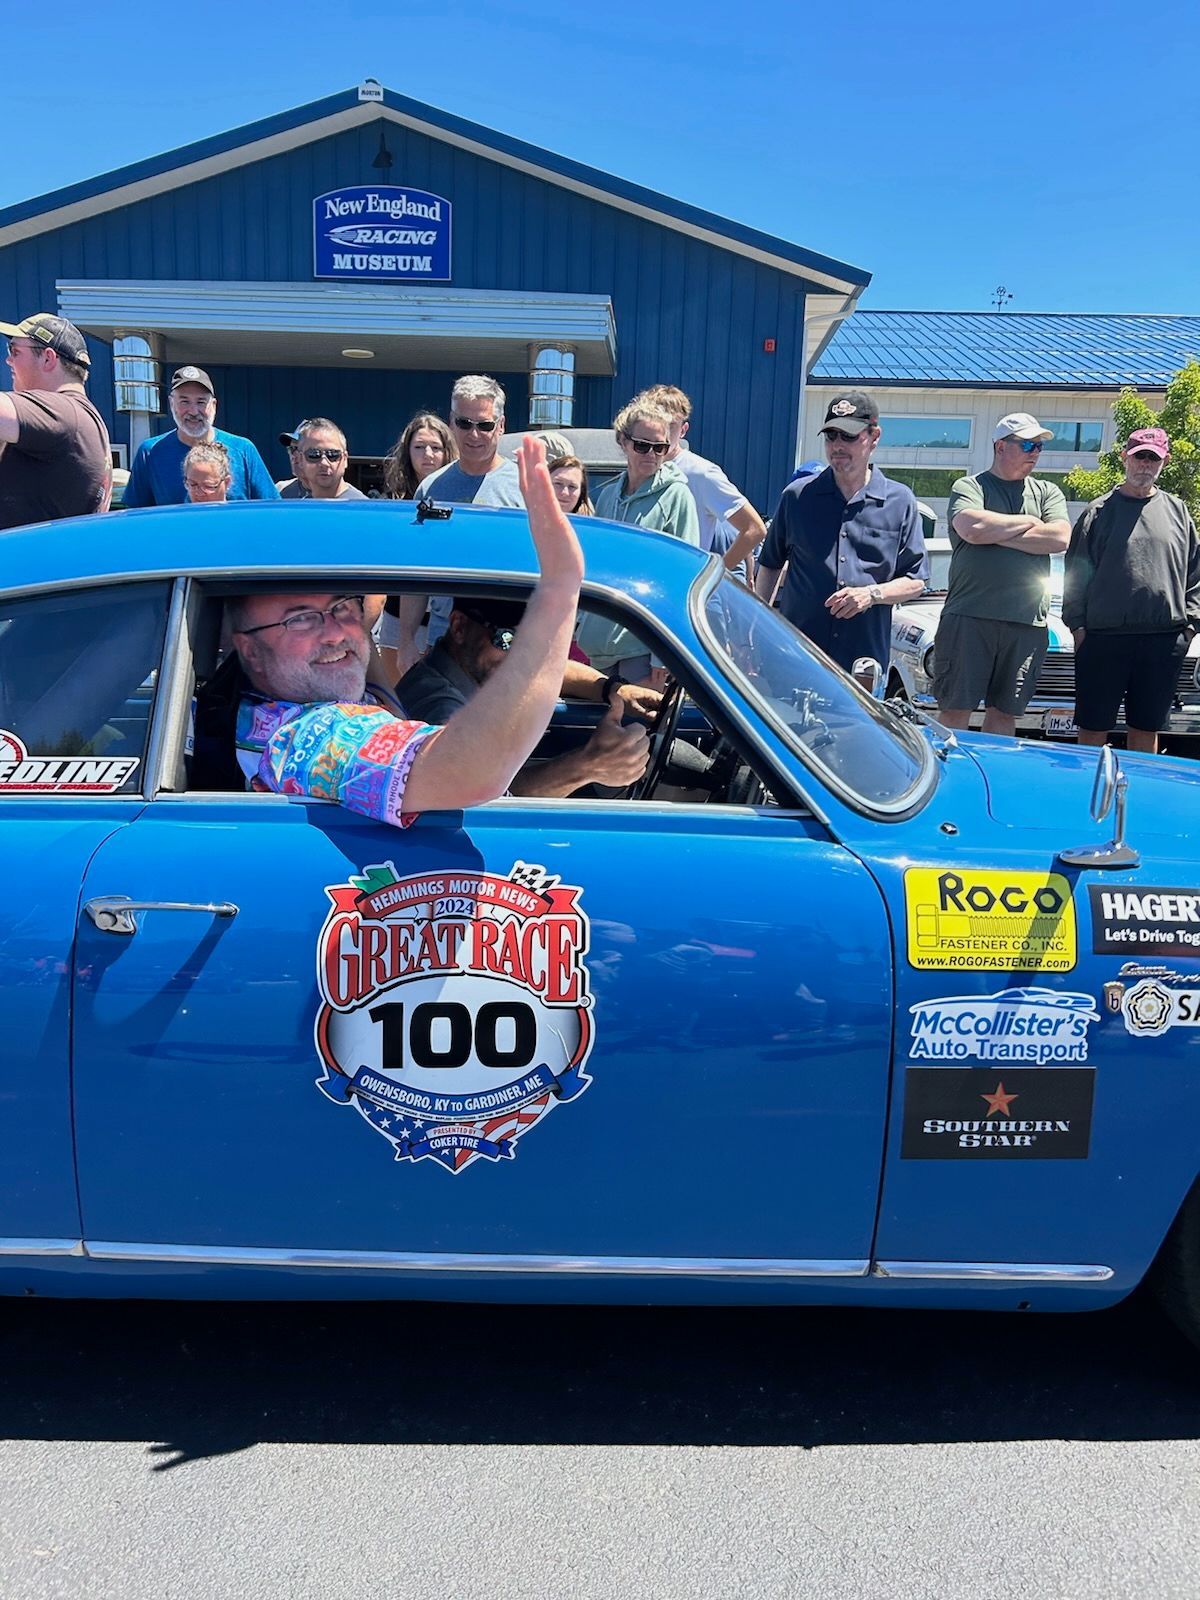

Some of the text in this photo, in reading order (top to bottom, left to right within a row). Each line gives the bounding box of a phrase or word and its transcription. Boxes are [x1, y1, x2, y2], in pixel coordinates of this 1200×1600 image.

[324, 194, 441, 222] New England
[353, 229, 437, 245] RACING
[333, 253, 432, 272] MUSEUM
[370, 879, 538, 912] HEMMINGS MOTOR NEWS
[938, 871, 1064, 914] ROGO
[435, 899, 475, 915] 2024
[940, 939, 1068, 951] FASTENER CO., INC.
[1105, 928, 1137, 942] Let's
[1139, 928, 1175, 943] Drive
[325, 916, 577, 1004] GREAT RACE
[917, 956, 1070, 968] www.ROGOFASTENER.com
[914, 1010, 1087, 1037] McCollister's
[368, 1001, 537, 1069] 100
[913, 1037, 1086, 1061] Auto Transport
[360, 1074, 432, 1111] OWENSBORO,
[434, 1098, 450, 1112] KY
[450, 1101, 463, 1112] TO
[464, 1085, 526, 1112] GARDINER,
[525, 1074, 544, 1092] ME
[433, 1127, 468, 1135] PRESENTED
[923, 1119, 1070, 1134] SOUTHERN
[430, 1136, 480, 1149] COKER TIRE
